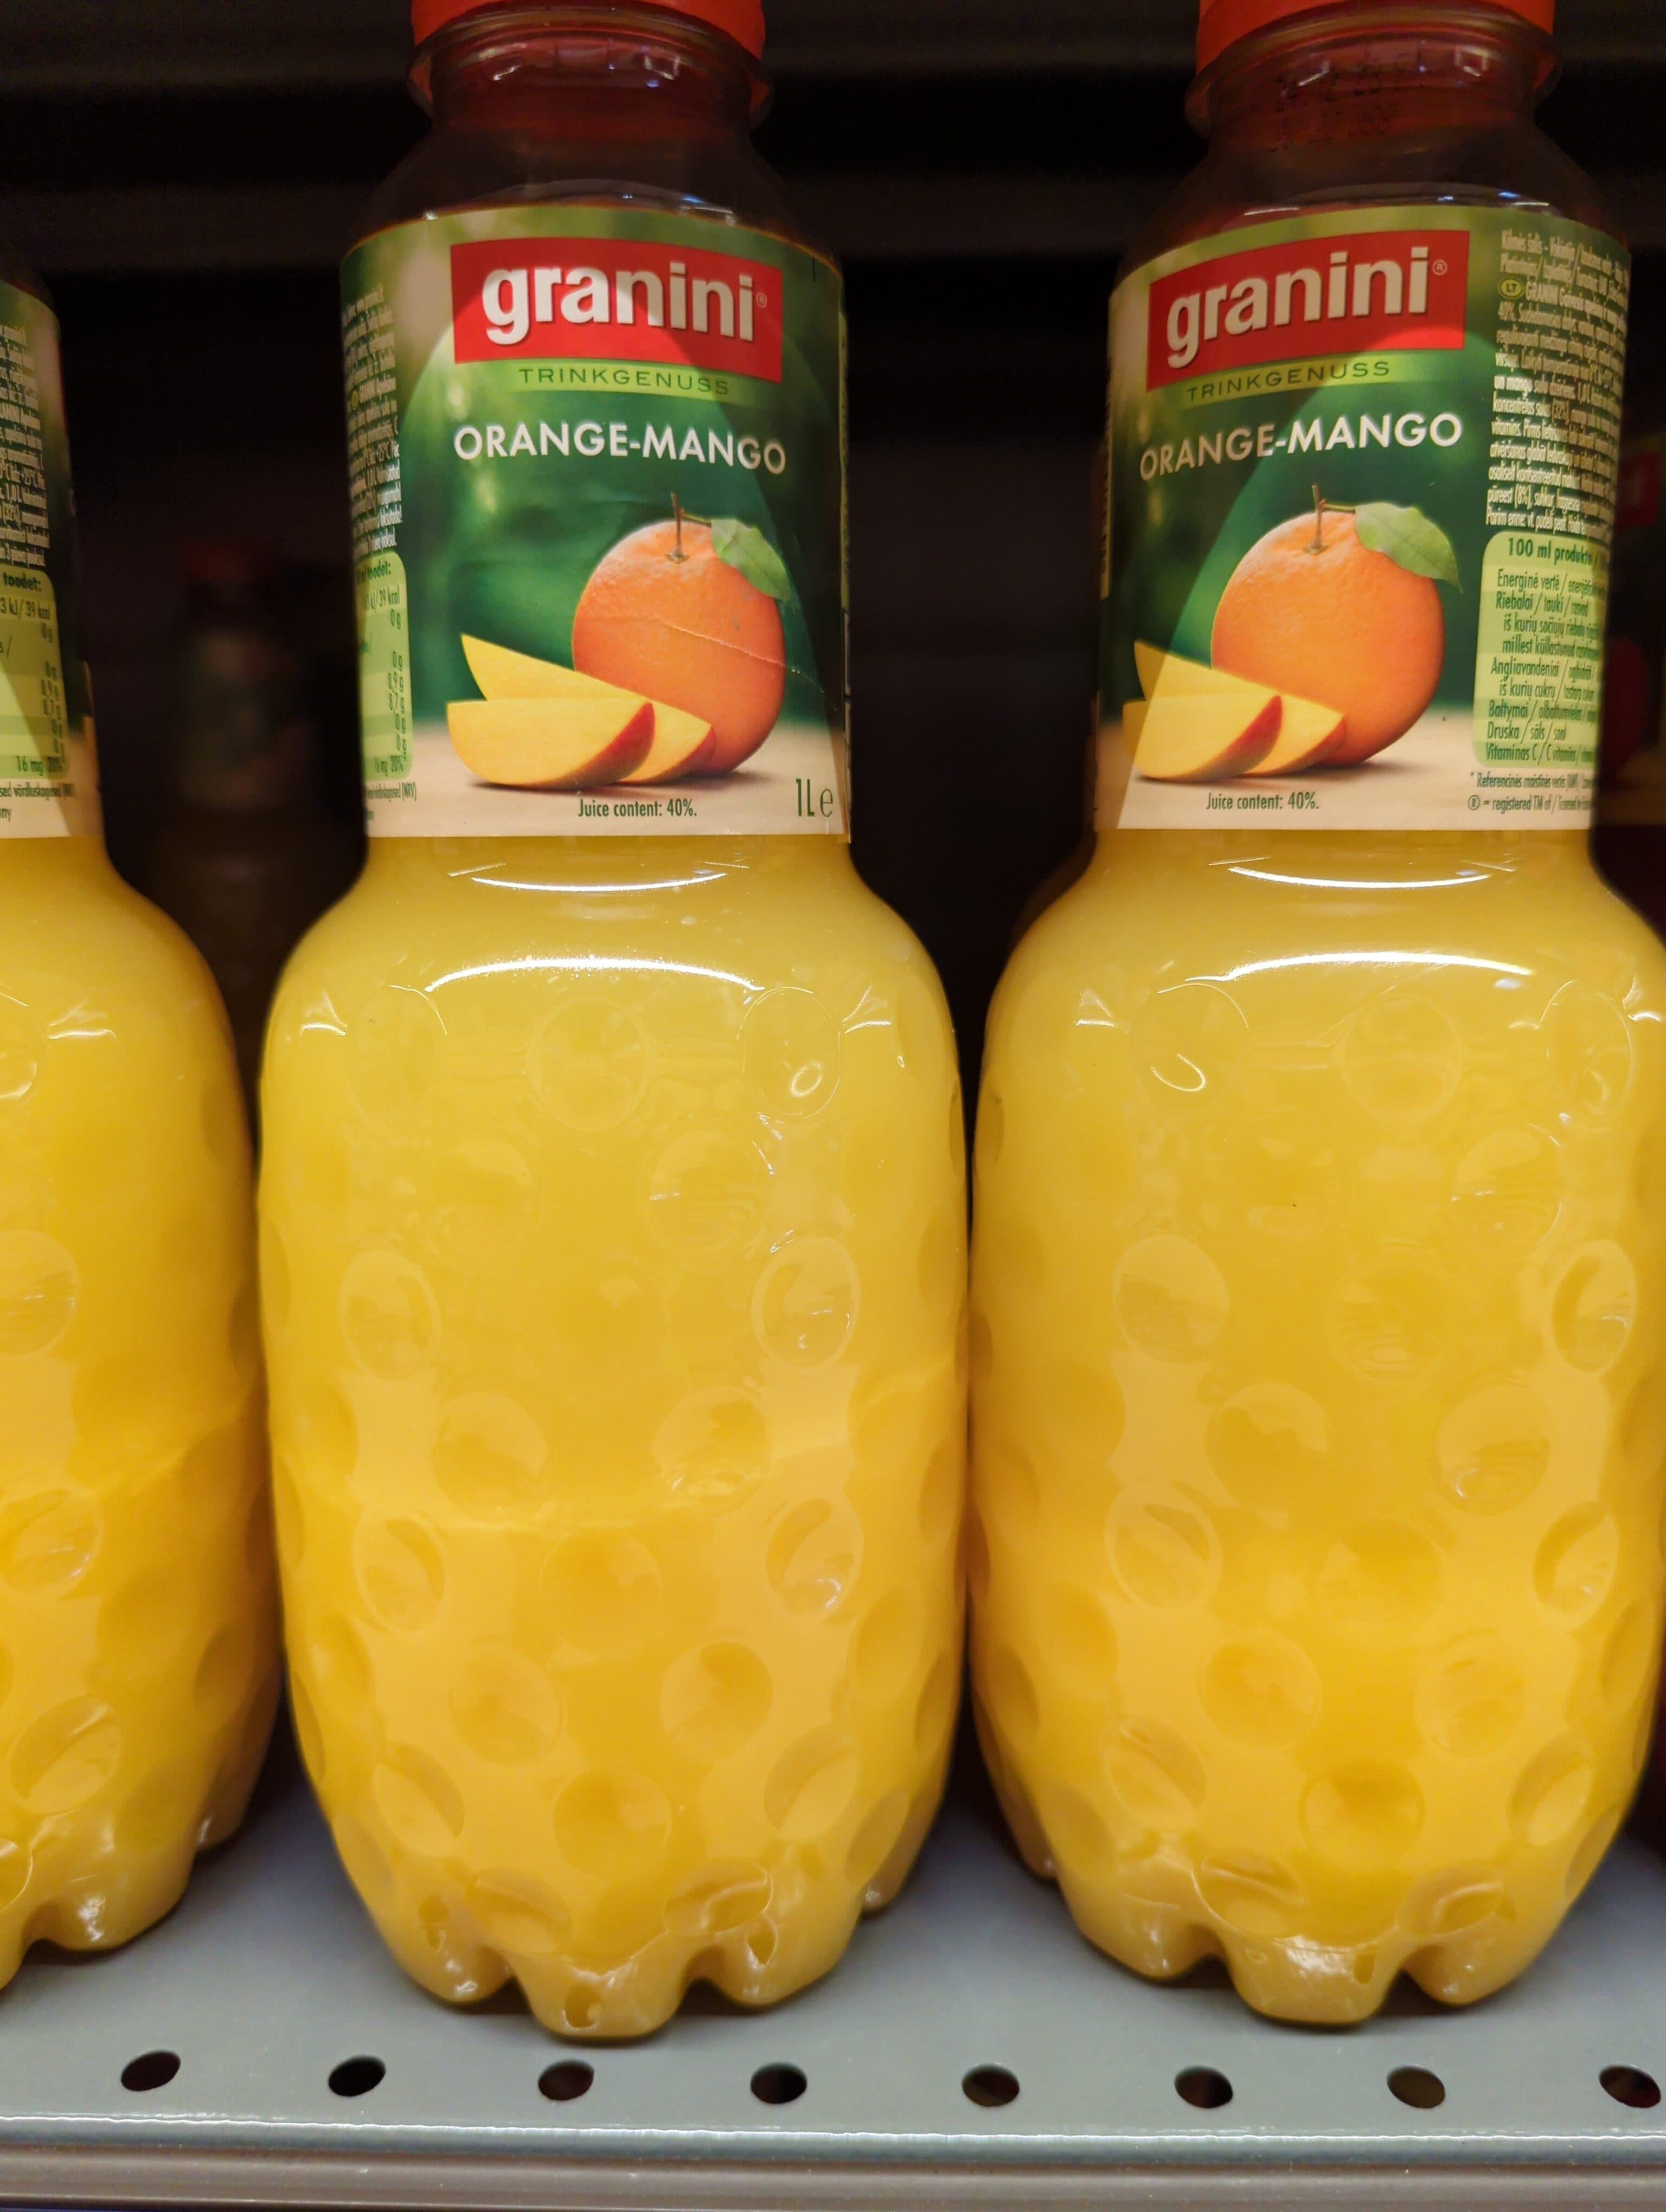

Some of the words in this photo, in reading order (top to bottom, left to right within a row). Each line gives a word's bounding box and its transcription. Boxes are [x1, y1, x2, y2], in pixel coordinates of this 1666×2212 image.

[518, 369, 729, 395] TRINKGENUSS
[1187, 362, 1390, 402] TRINKGENUSS
[454, 421, 786, 474] ORANGE-MANGO
[1139, 412, 1463, 481] ORANGE-MANGO
[1508, 538, 1533, 557] 100
[1537, 541, 1550, 558] ml
[1497, 569, 1538, 593] Energinė
[1541, 575, 1559, 591] vertė
[1496, 591, 1533, 610] Riebalai
[1504, 613, 1511, 632] iš
[1514, 612, 1537, 635] kurių
[1502, 634, 1533, 653] millest
[1491, 655, 1559, 681] Angliavandeniai
[1500, 679, 1507, 696] iš
[1509, 678, 1532, 700] kurių
[1489, 699, 1528, 722] Baltymai
[1487, 722, 1520, 739] Druska
[1486, 742, 1529, 761] Vitaminas
[578, 799, 609, 817] Juice
[614, 800, 662, 816] content:
[667, 799, 697, 816] 40%.
[1206, 793, 1233, 809] Juice
[1237, 794, 1283, 809] content:
[1287, 792, 1319, 809] 40%.
[1492, 795, 1531, 814] registered
